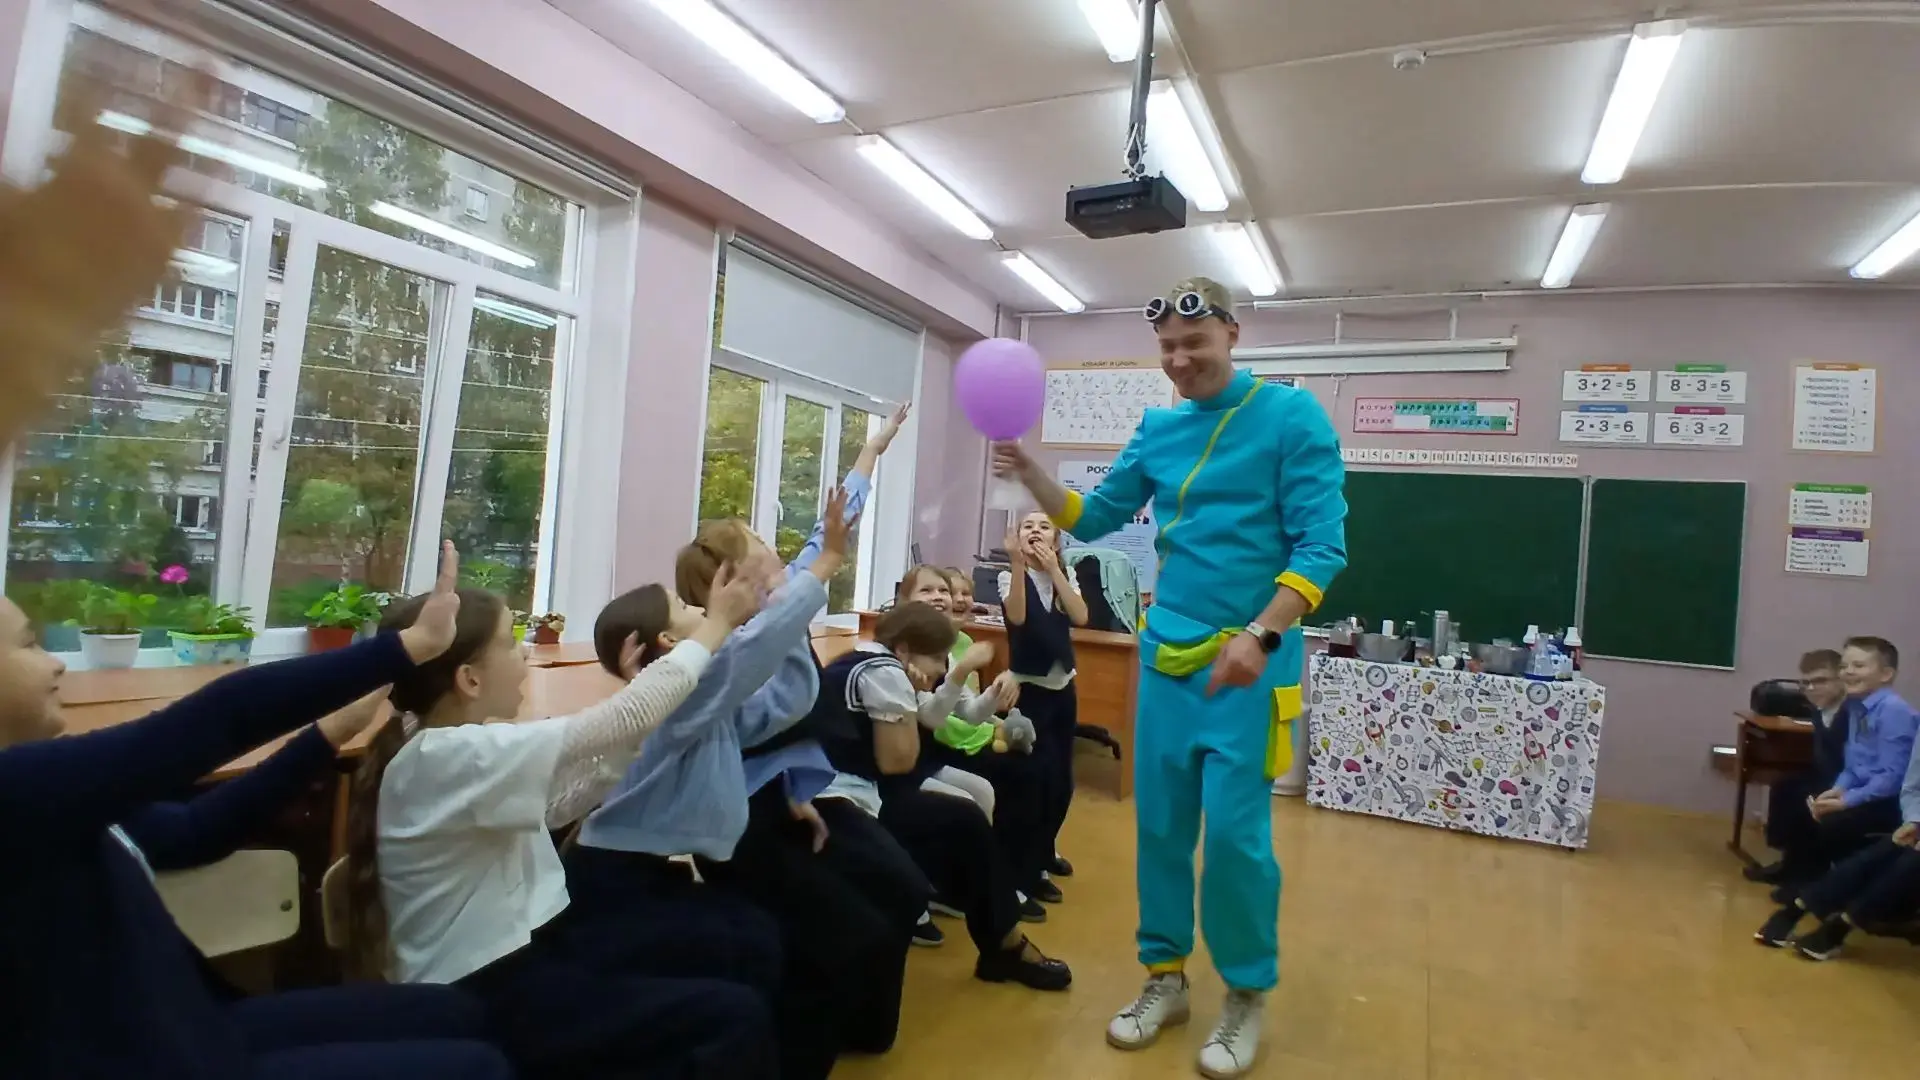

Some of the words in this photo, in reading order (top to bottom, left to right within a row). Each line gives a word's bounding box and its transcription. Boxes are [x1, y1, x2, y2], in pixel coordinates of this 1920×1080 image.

[1578, 379, 1588, 391] 3
[1601, 379, 1611, 391] 2
[1626, 379, 1636, 391] 5
[1670, 379, 1680, 391] 8
[1696, 380, 1707, 392] 3
[1720, 380, 1731, 392] 5
[1575, 420, 1585, 432] 2
[1599, 420, 1609, 432] 3
[1623, 420, 1634, 433] 6
[1669, 421, 1680, 434] 6
[1694, 422, 1704, 435] 3
[1718, 422, 1729, 435] 2
[1432, 453, 1443, 461] 10
[1446, 453, 1455, 461] 11
[1459, 453, 1469, 462] 12
[1471, 454, 1482, 462] 13
[1485, 454, 1495, 463] 14
[1498, 455, 1508, 463] 15
[1511, 455, 1521, 463] 16
[1525, 455, 1535, 463] 17
[1538, 456, 1549, 464] 18
[1552, 456, 1563, 465] 19
[1566, 456, 1577, 465] 20
